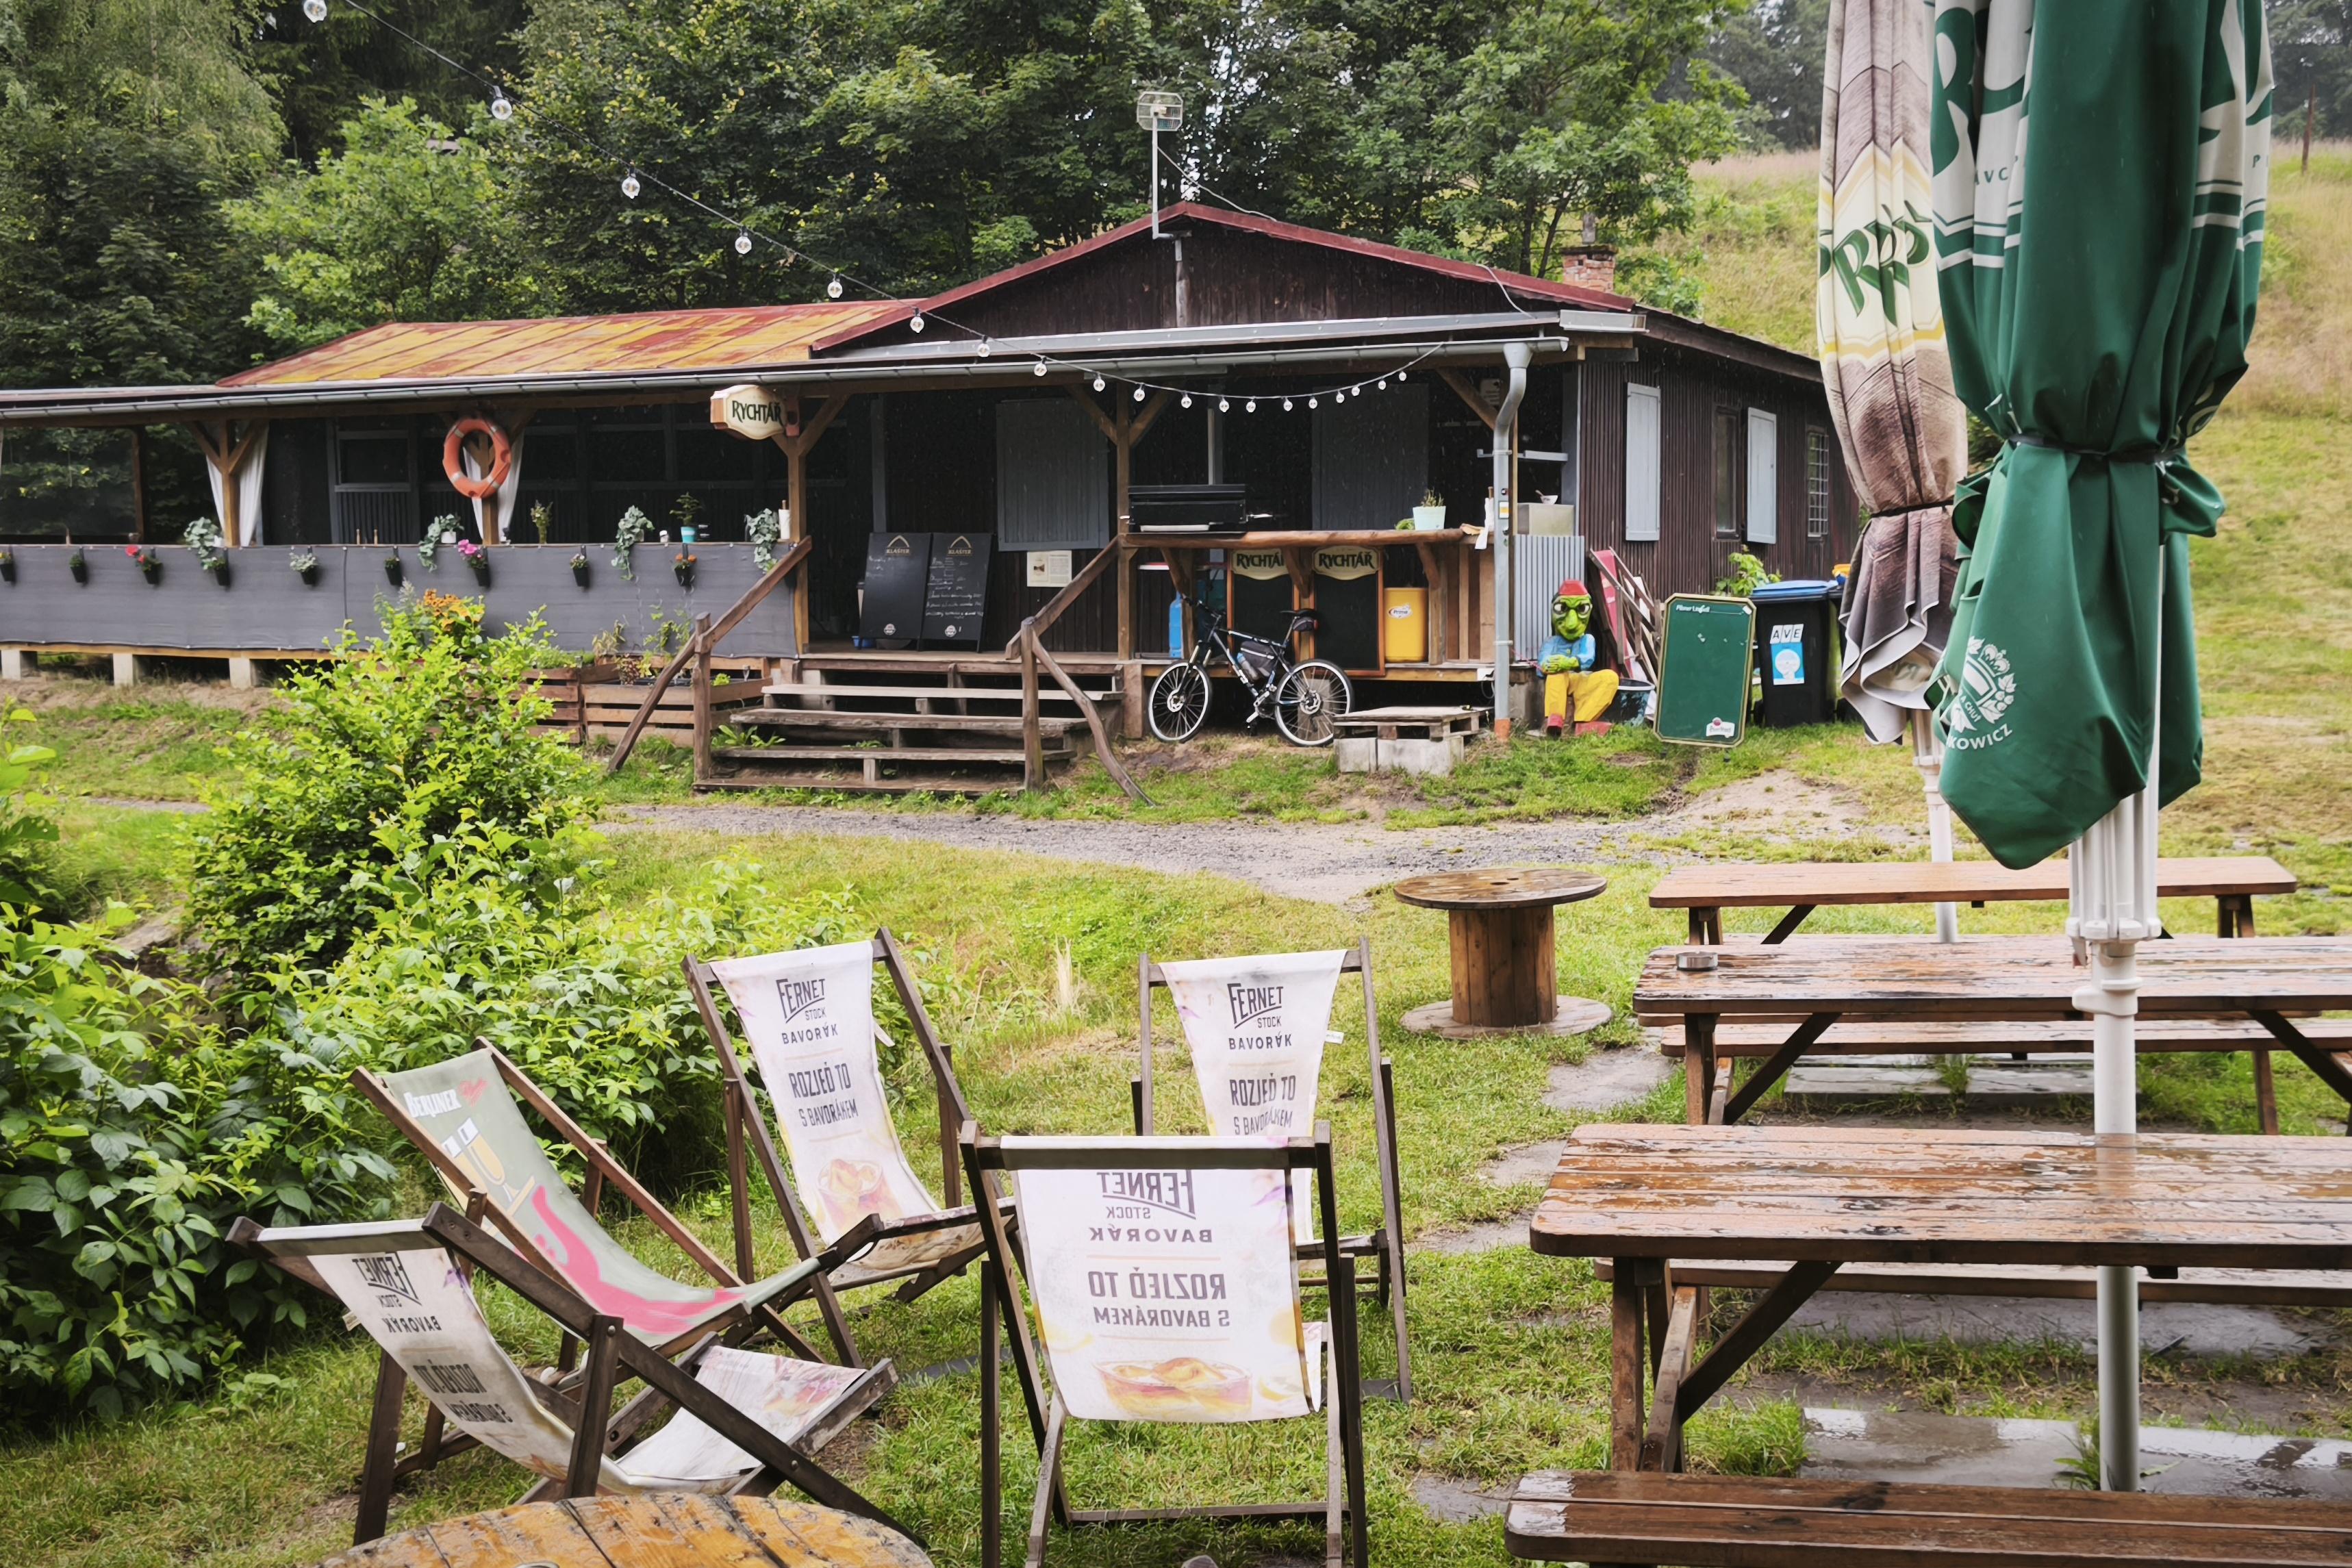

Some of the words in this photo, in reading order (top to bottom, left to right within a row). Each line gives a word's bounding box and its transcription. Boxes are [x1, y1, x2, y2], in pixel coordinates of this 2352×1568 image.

[732, 400, 784, 426] RYCHTÁŘ
[1319, 552, 1375, 569] RYCHTÁŘ
[1773, 629, 1801, 639] AVE
[1946, 723, 2013, 750] KOWICZ
[776, 978, 826, 1019] FERNET
[1227, 983, 1284, 1024] FERNET
[805, 1007, 826, 1021] STOCK
[1257, 1016, 1282, 1028] STOCK
[835, 1063, 851, 1090] TO
[1281, 1075, 1296, 1101] TO
[798, 1109, 808, 1127] S
[1233, 1116, 1241, 1135] S
